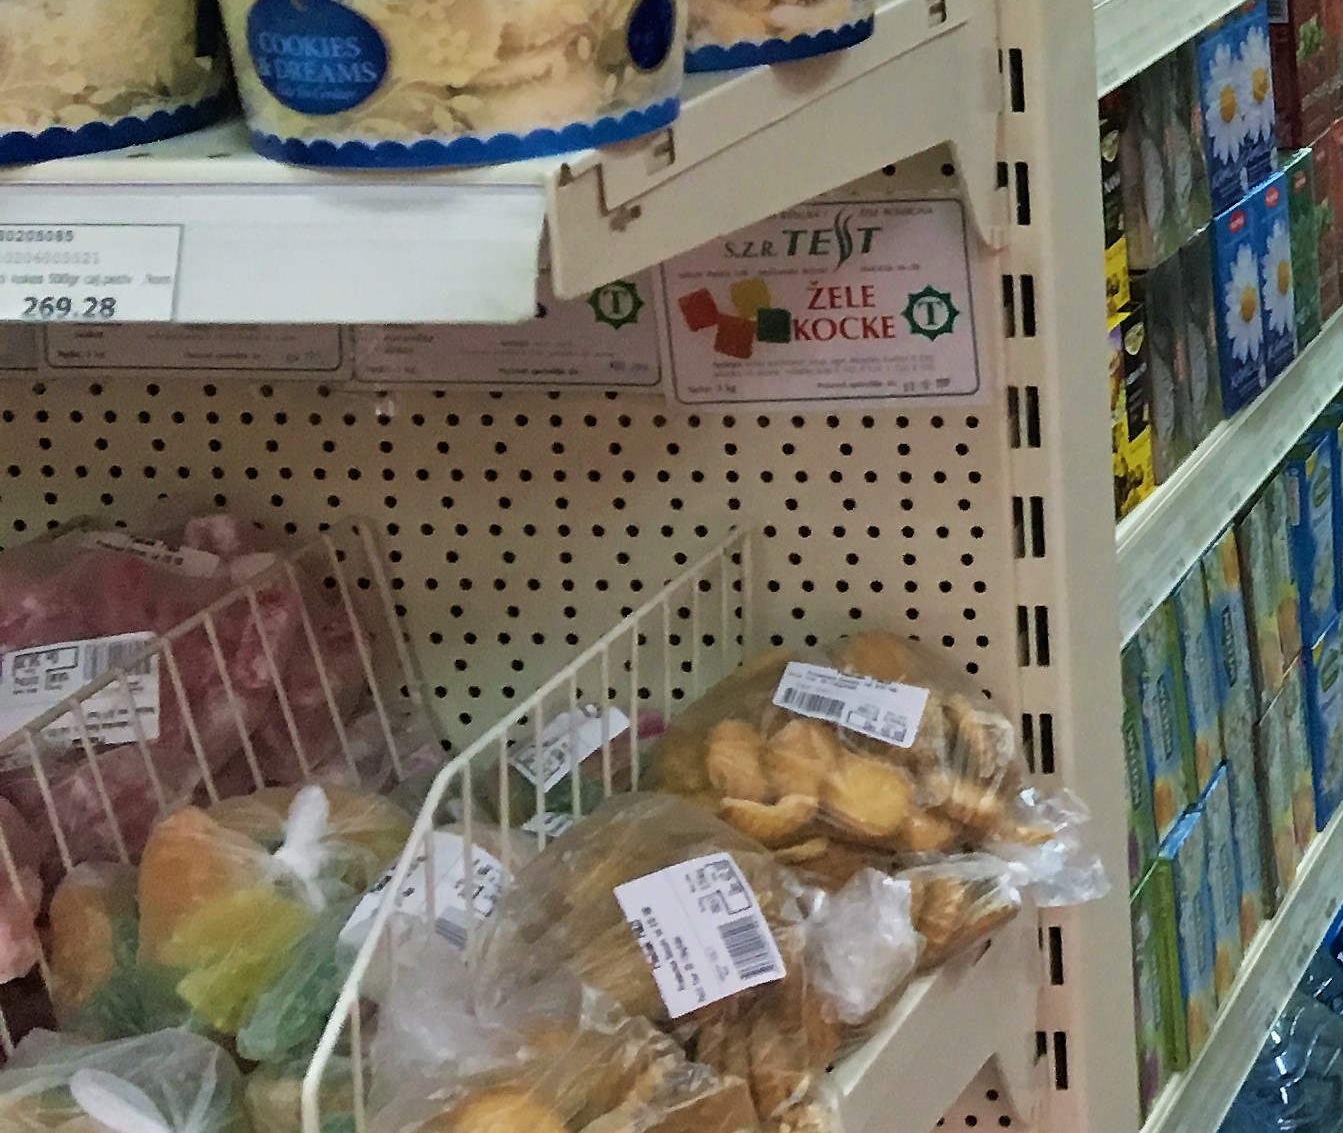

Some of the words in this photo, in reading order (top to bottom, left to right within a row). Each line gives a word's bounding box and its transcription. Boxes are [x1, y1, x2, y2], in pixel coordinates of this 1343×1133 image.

[258, 32, 361, 58] COOKIES
[275, 58, 378, 83] DREAMS
[723, 241, 778, 259] S.Z.R.
[782, 206, 882, 271] TEST
[22, 296, 118, 318] 269.28
[806, 280, 876, 310] ŽELE
[918, 300, 944, 326] T
[792, 315, 896, 342] KOCKE
